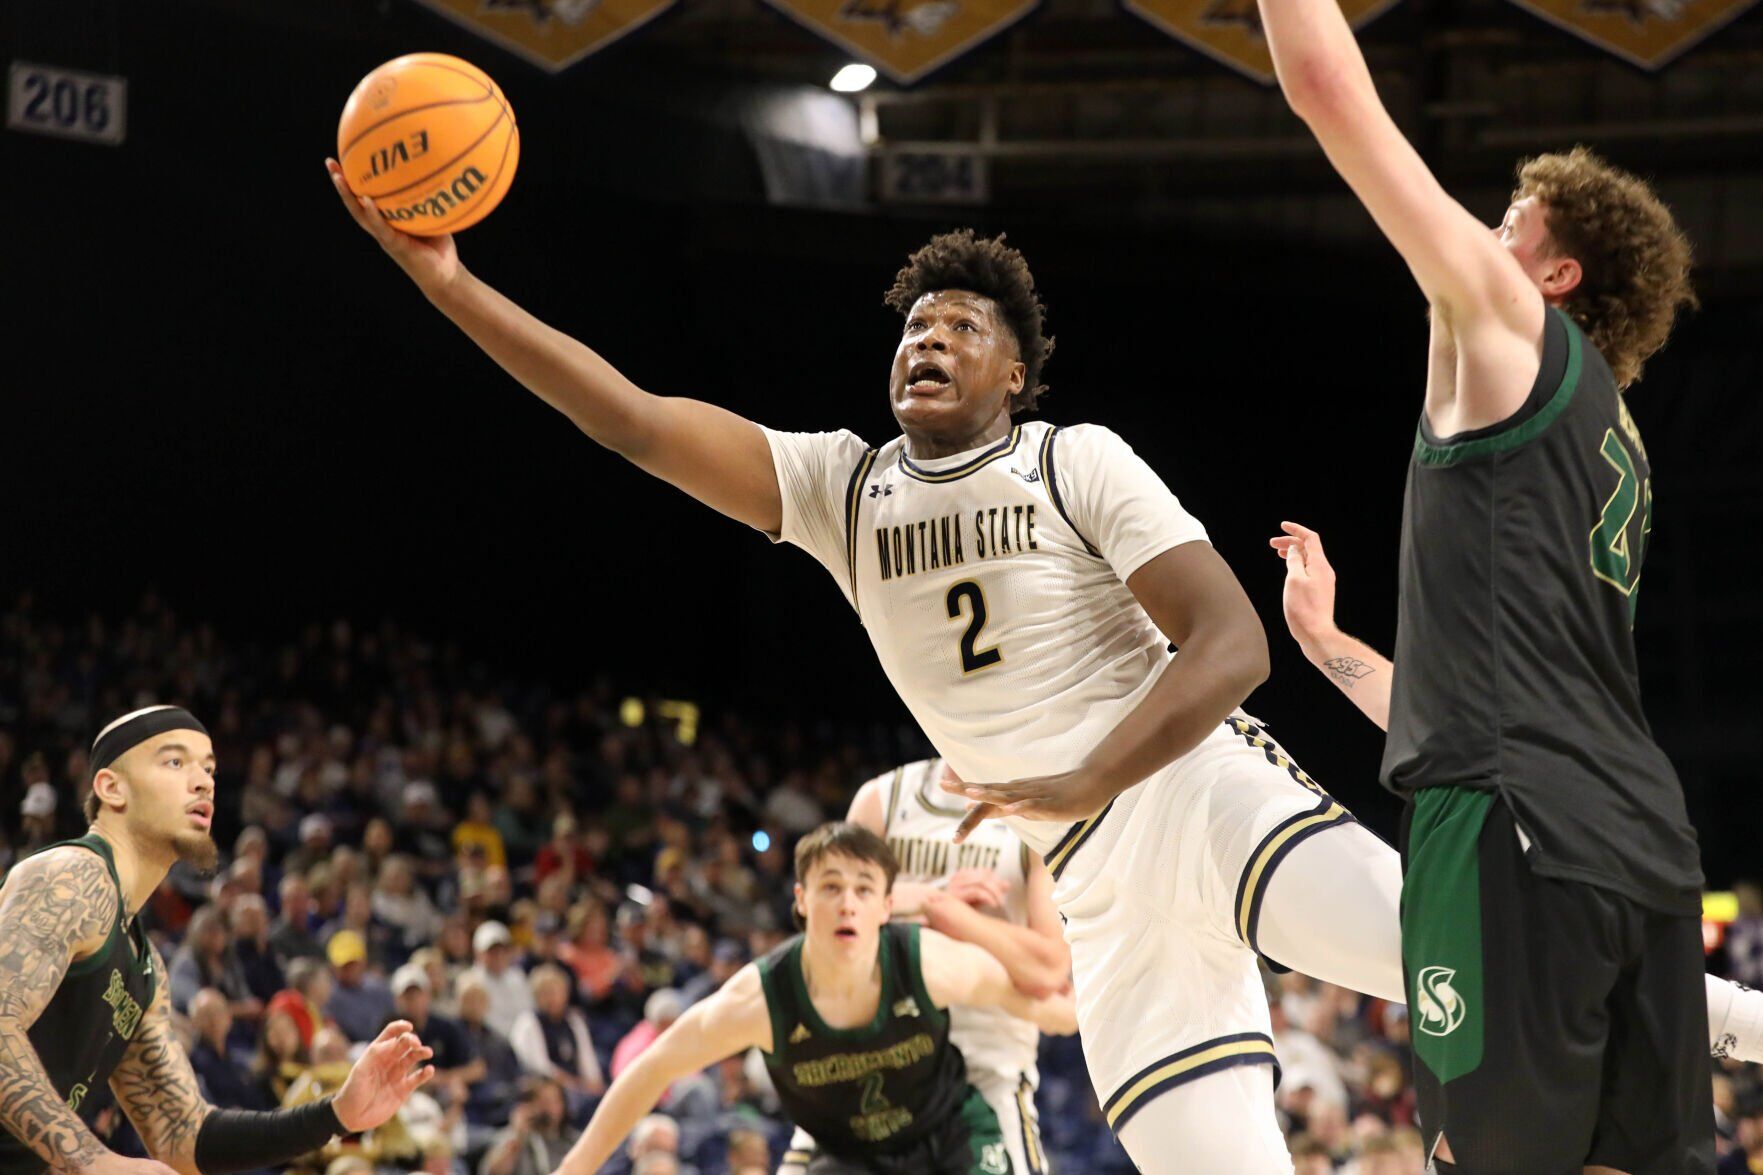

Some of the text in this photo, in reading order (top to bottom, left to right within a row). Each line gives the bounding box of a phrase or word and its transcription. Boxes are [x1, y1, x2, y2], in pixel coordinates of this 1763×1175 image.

[24, 74, 112, 133] 206
[379, 166, 487, 221] Wilson
[876, 504, 1038, 581] MONTANA STATE
[945, 577, 1004, 677] 2
